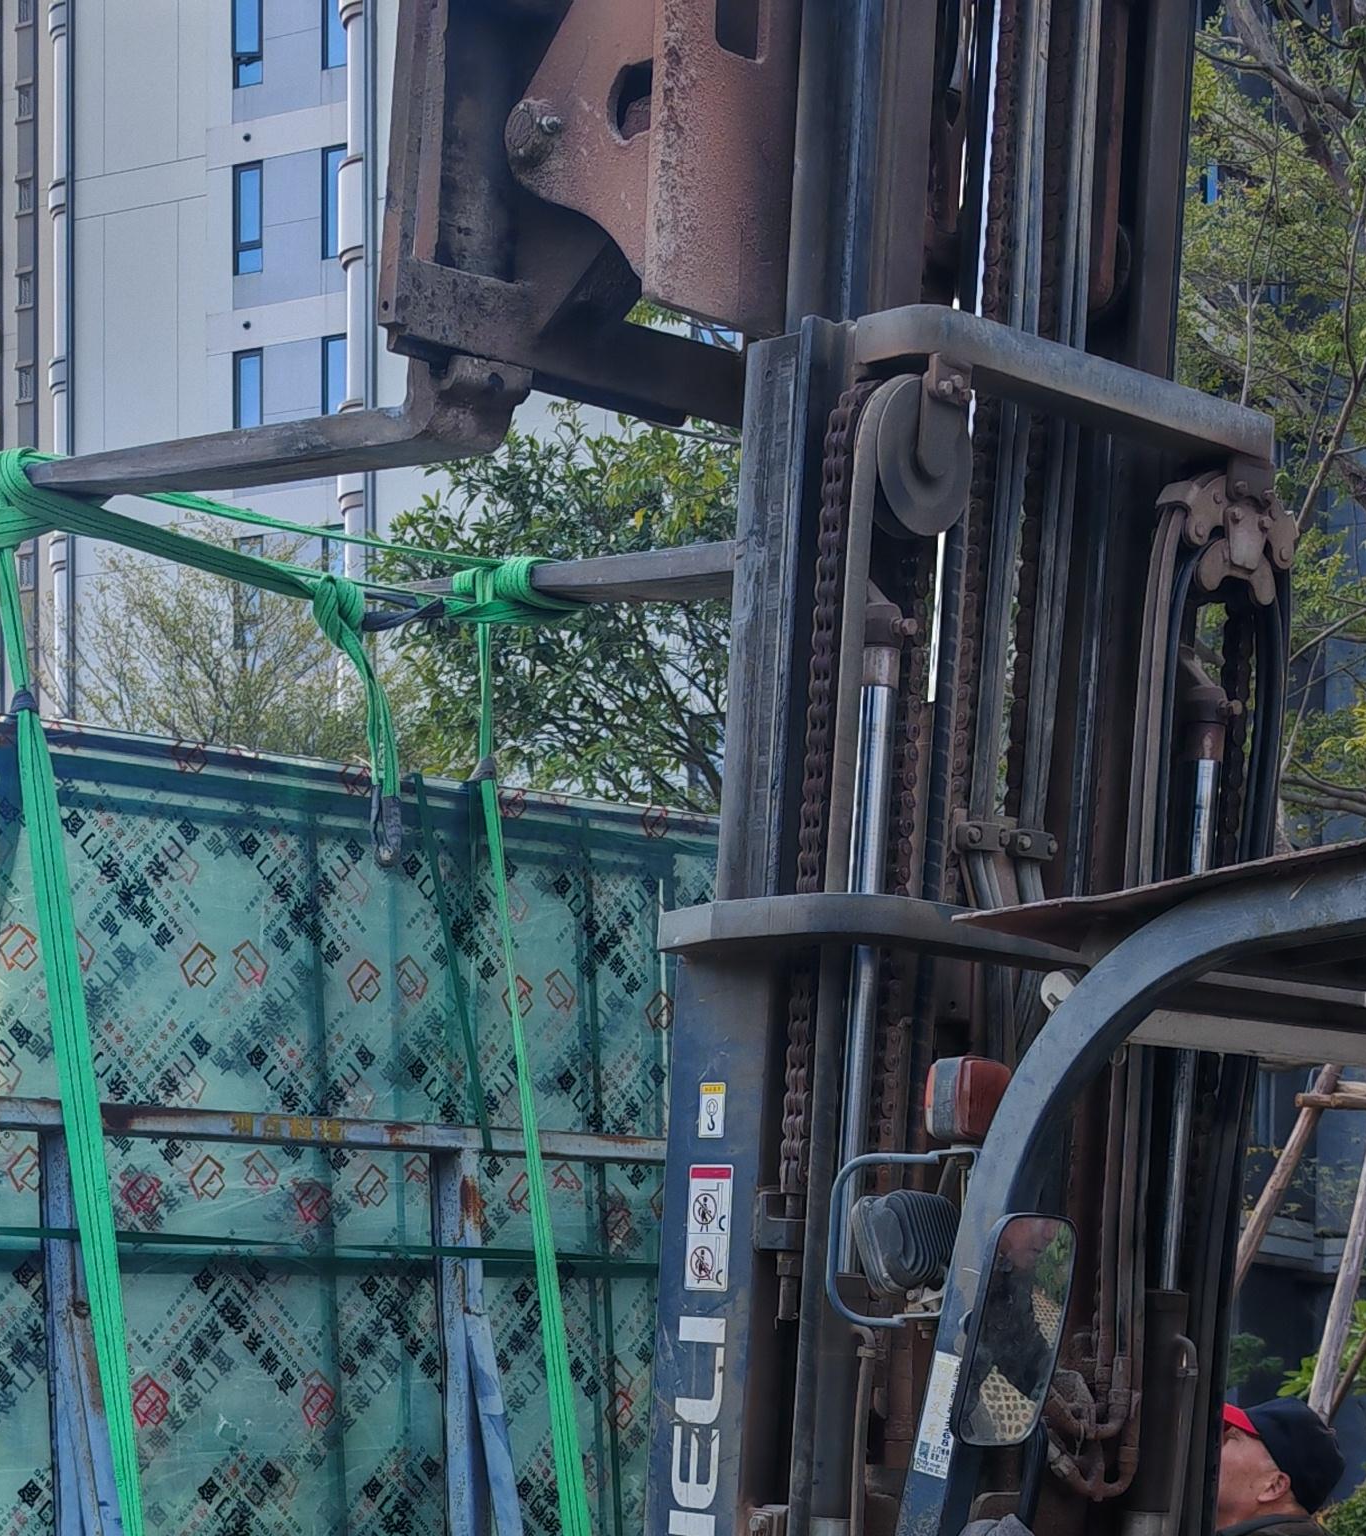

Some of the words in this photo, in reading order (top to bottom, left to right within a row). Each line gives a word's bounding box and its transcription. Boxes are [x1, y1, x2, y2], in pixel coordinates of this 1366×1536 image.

[57, 806, 179, 953] 高端系统门窗
